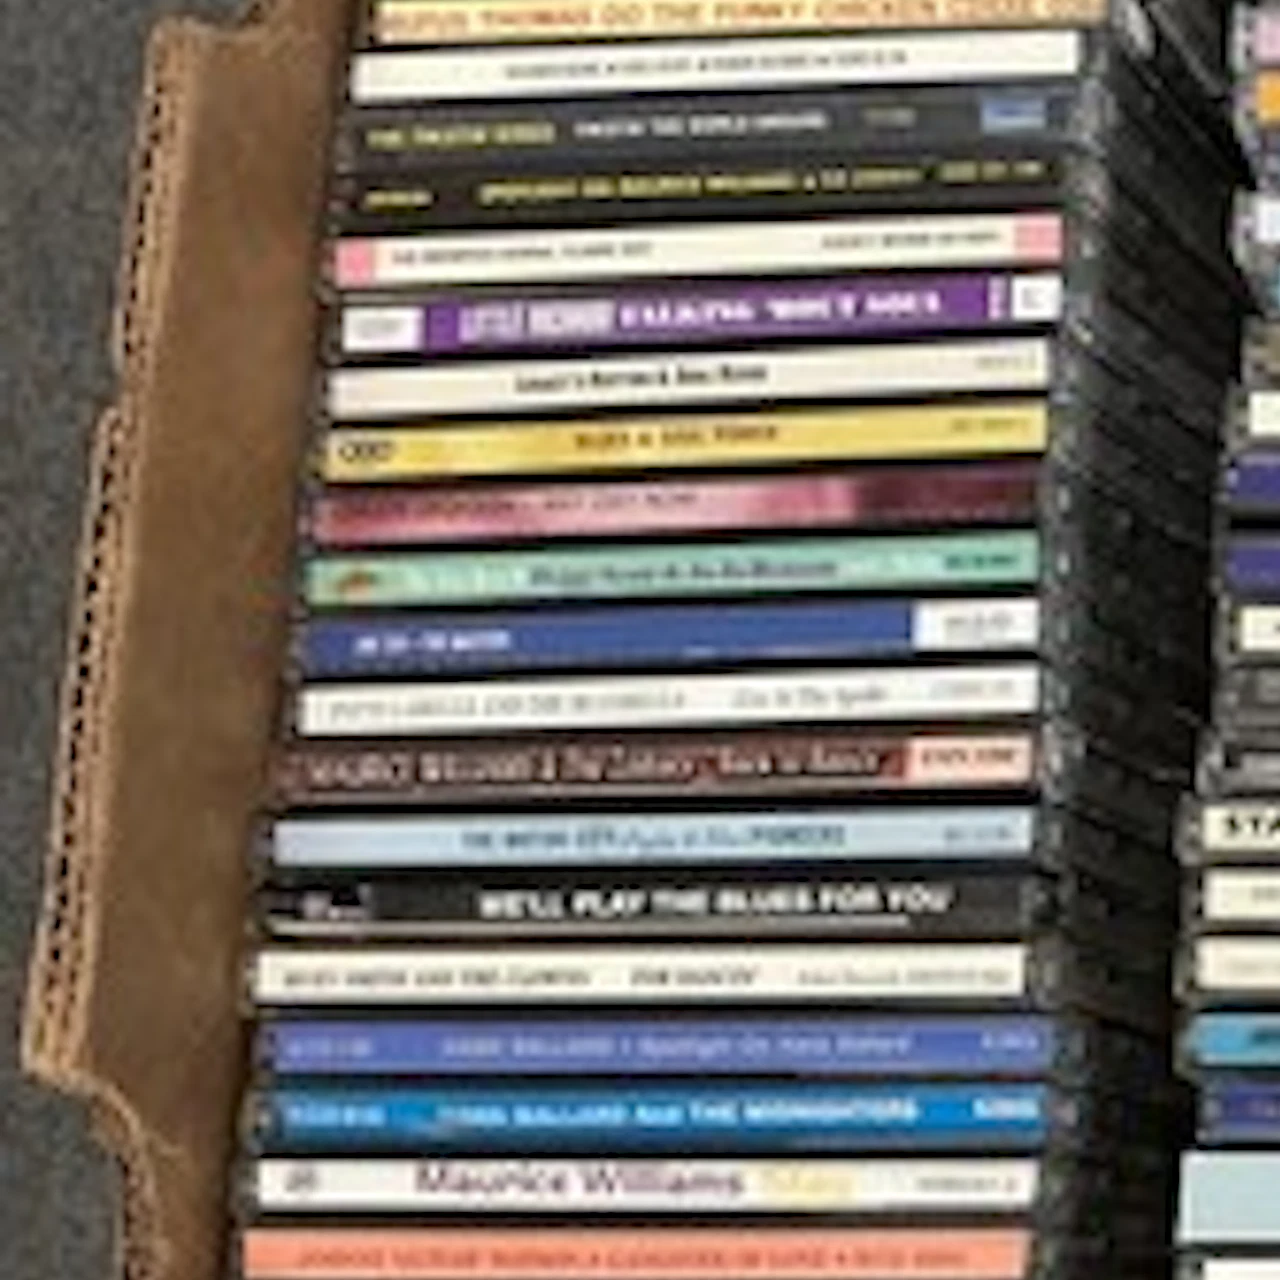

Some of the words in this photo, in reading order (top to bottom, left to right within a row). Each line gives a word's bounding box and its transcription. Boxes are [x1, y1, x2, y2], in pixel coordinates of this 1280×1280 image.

[574, 890, 645, 918] PLAY
[715, 888, 811, 916] BLUES
[885, 886, 953, 914] YOU
[415, 1165, 566, 1195] Maurice
[580, 1166, 743, 1196] Williams
